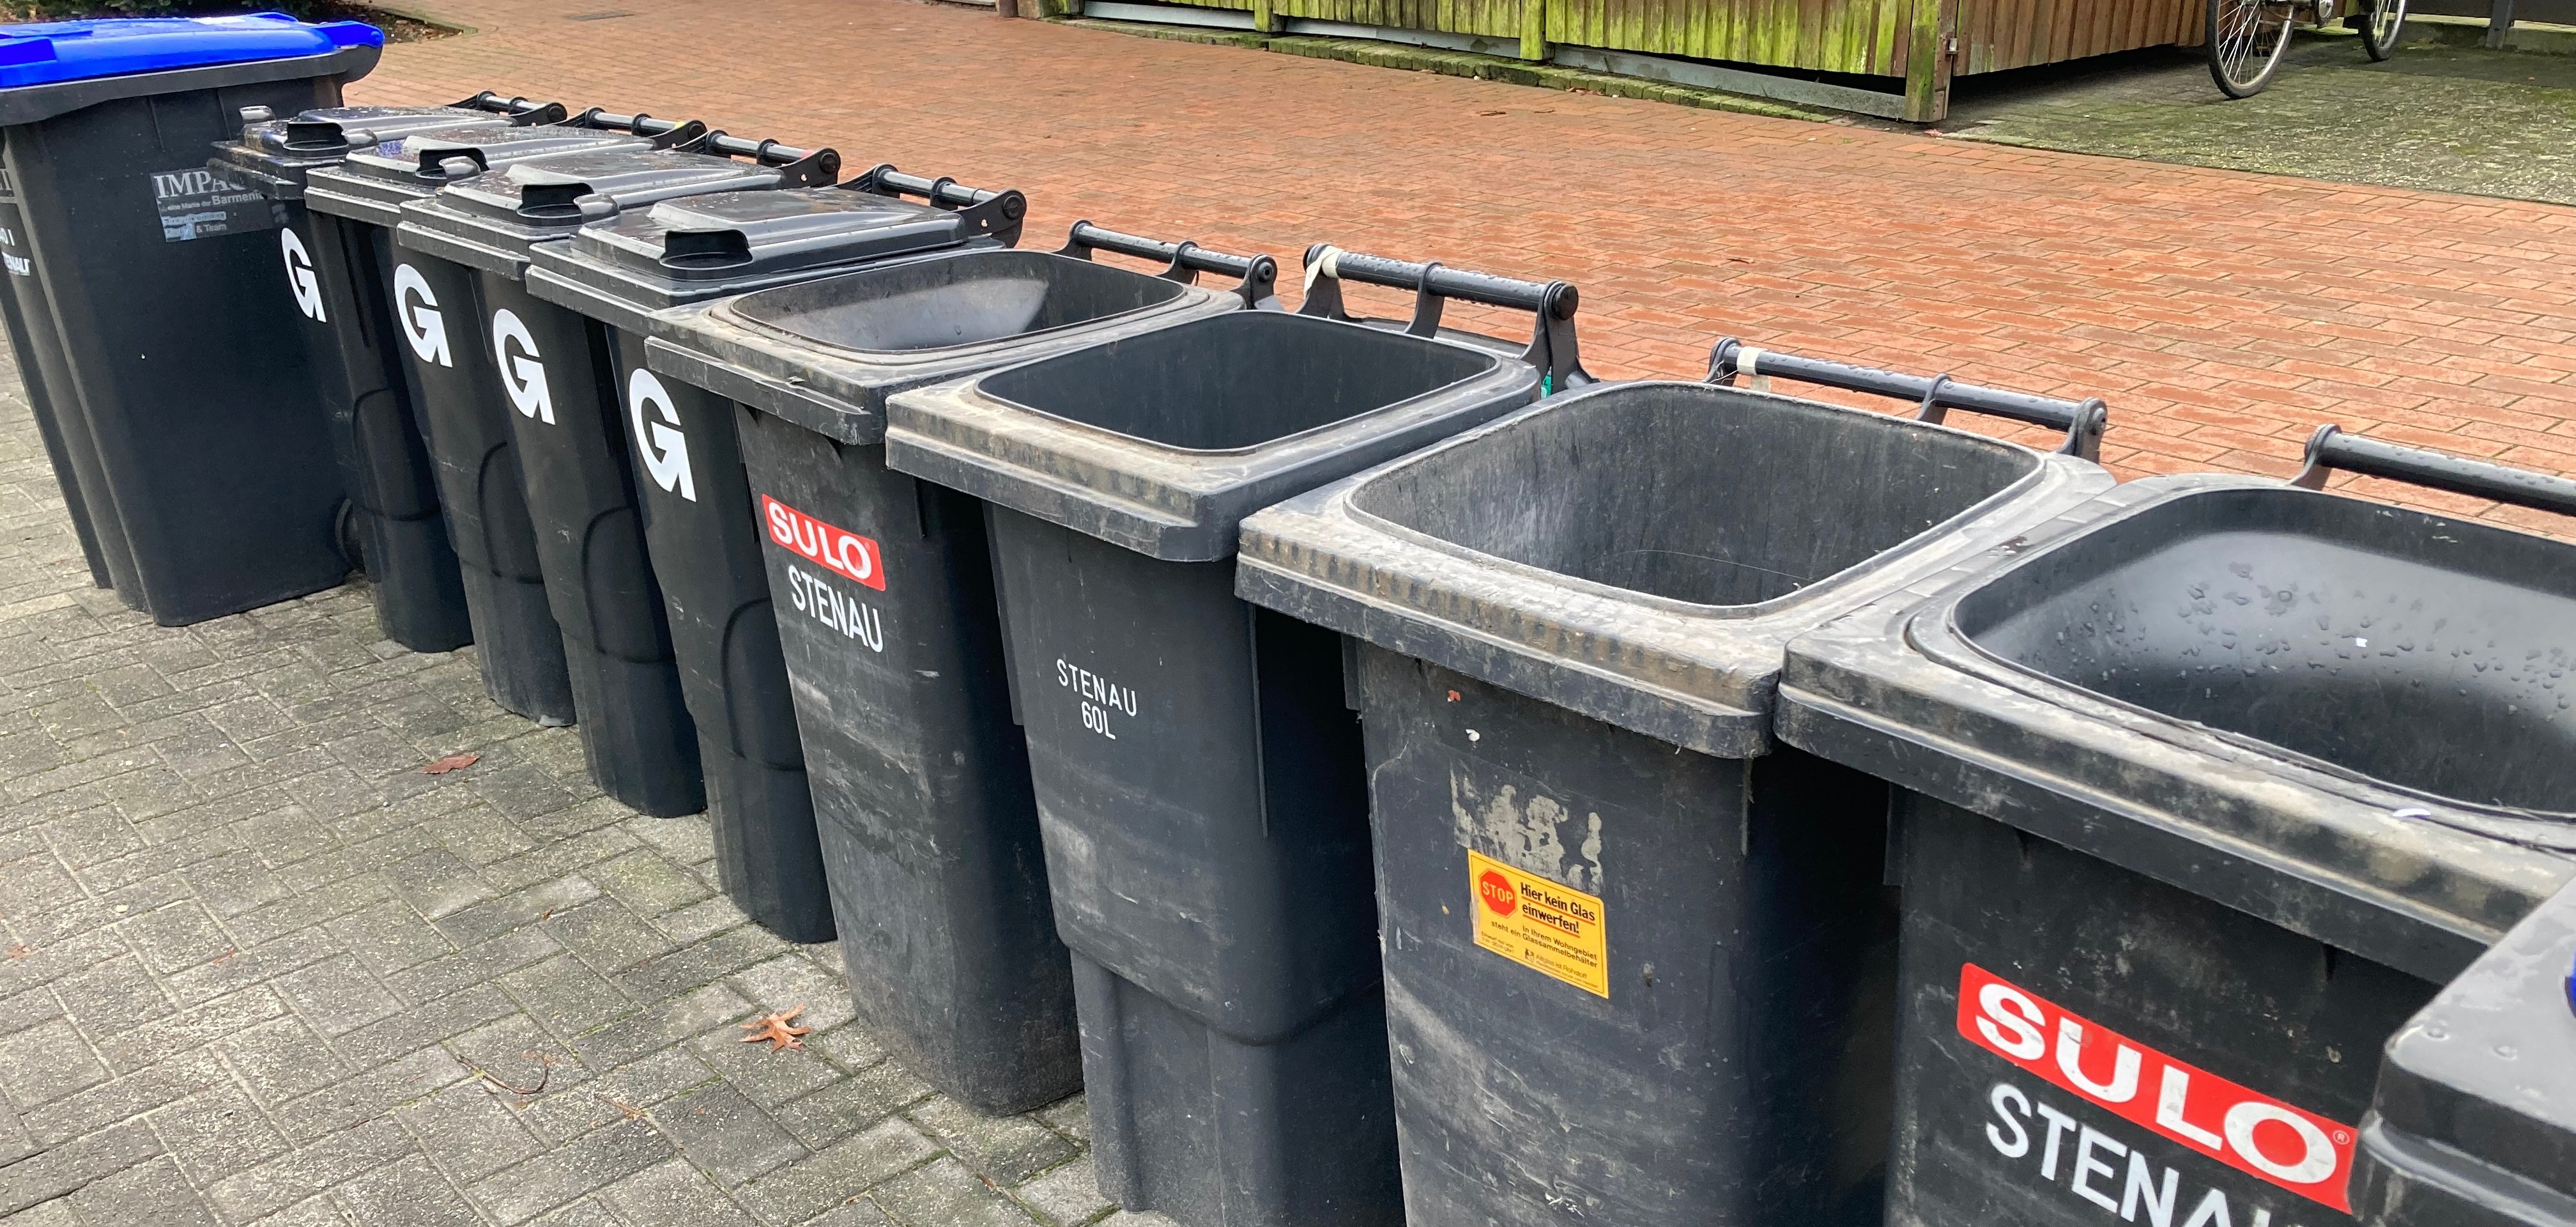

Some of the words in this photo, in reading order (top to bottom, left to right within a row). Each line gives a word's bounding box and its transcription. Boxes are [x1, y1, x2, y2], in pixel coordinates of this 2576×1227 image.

[154, 171, 247, 198] IMPA
[788, 565, 884, 652] STENAU
[1057, 658, 1137, 716] STENAU
[1082, 701, 1116, 739] 60L
[1482, 881, 1514, 904] STOP
[1521, 882, 1542, 901] Hier
[1545, 891, 1567, 911] kein
[1570, 902, 1595, 921] Glas
[1522, 903, 1579, 934] einwerfen!
[1491, 922, 1508, 932] steht
[1510, 929, 1521, 938] ein
[1522, 933, 1597, 968] Glassammelbehälter
[1531, 929, 1551, 942] Ihrem
[1553, 938, 1597, 961] Wohngebiet
[1985, 1084, 2303, 1227] STENA
